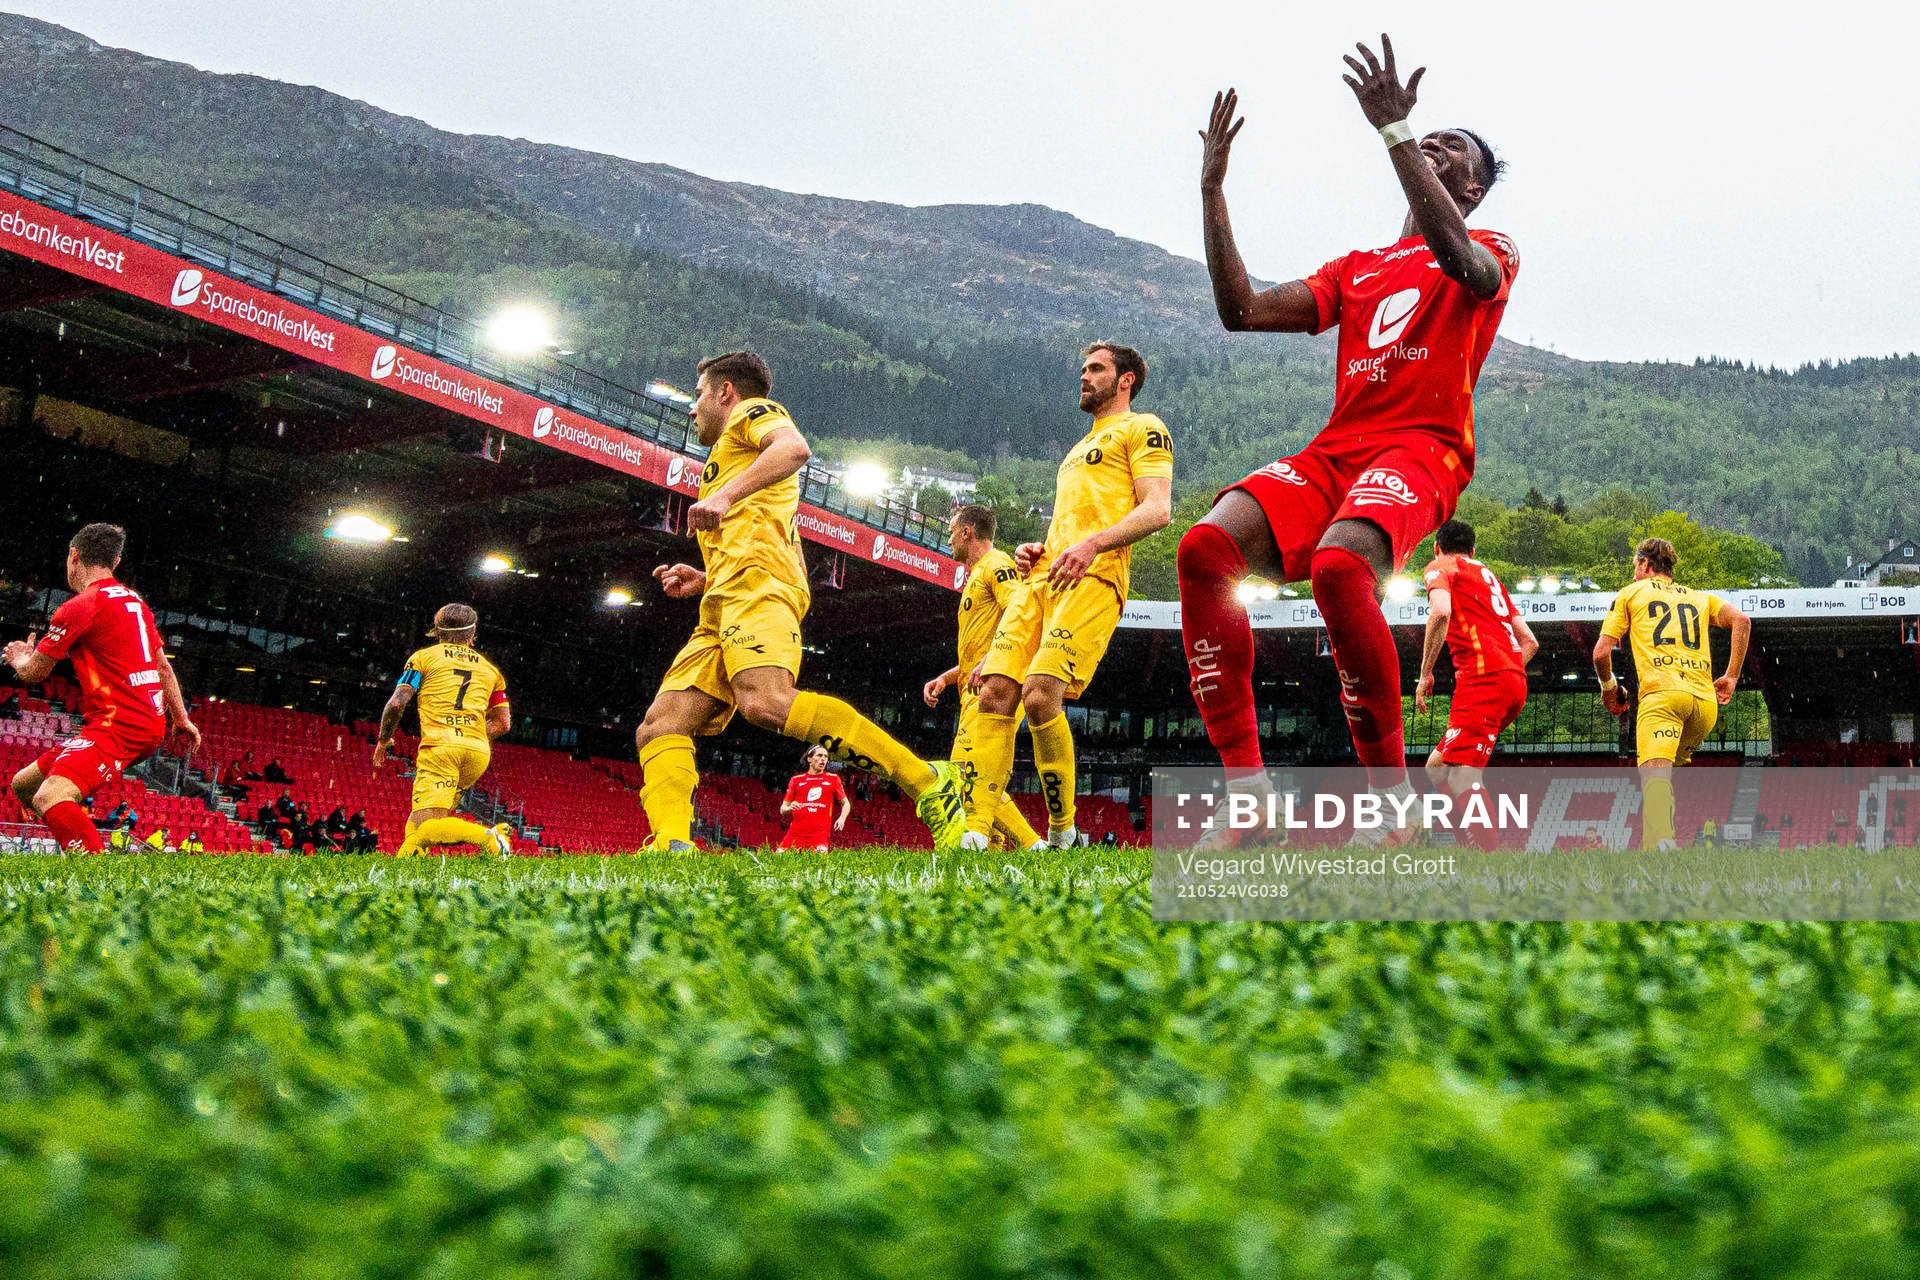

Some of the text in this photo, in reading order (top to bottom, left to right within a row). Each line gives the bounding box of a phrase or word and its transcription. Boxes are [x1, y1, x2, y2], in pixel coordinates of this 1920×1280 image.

[0, 210, 125, 274] ebankenVest
[201, 282, 335, 352] SparebankenVest
[395, 356, 503, 416] SparebankenVest
[552, 416, 642, 467] SparebankenVest
[884, 542, 940, 576] SparebankenVest
[1532, 603, 1556, 613] BOB
[1760, 599, 1786, 609] BOB
[1805, 600, 1847, 611] Rett hjem.
[1881, 597, 1906, 607] BOB
[1648, 600, 1701, 650] 20
[453, 668, 472, 711] 7
